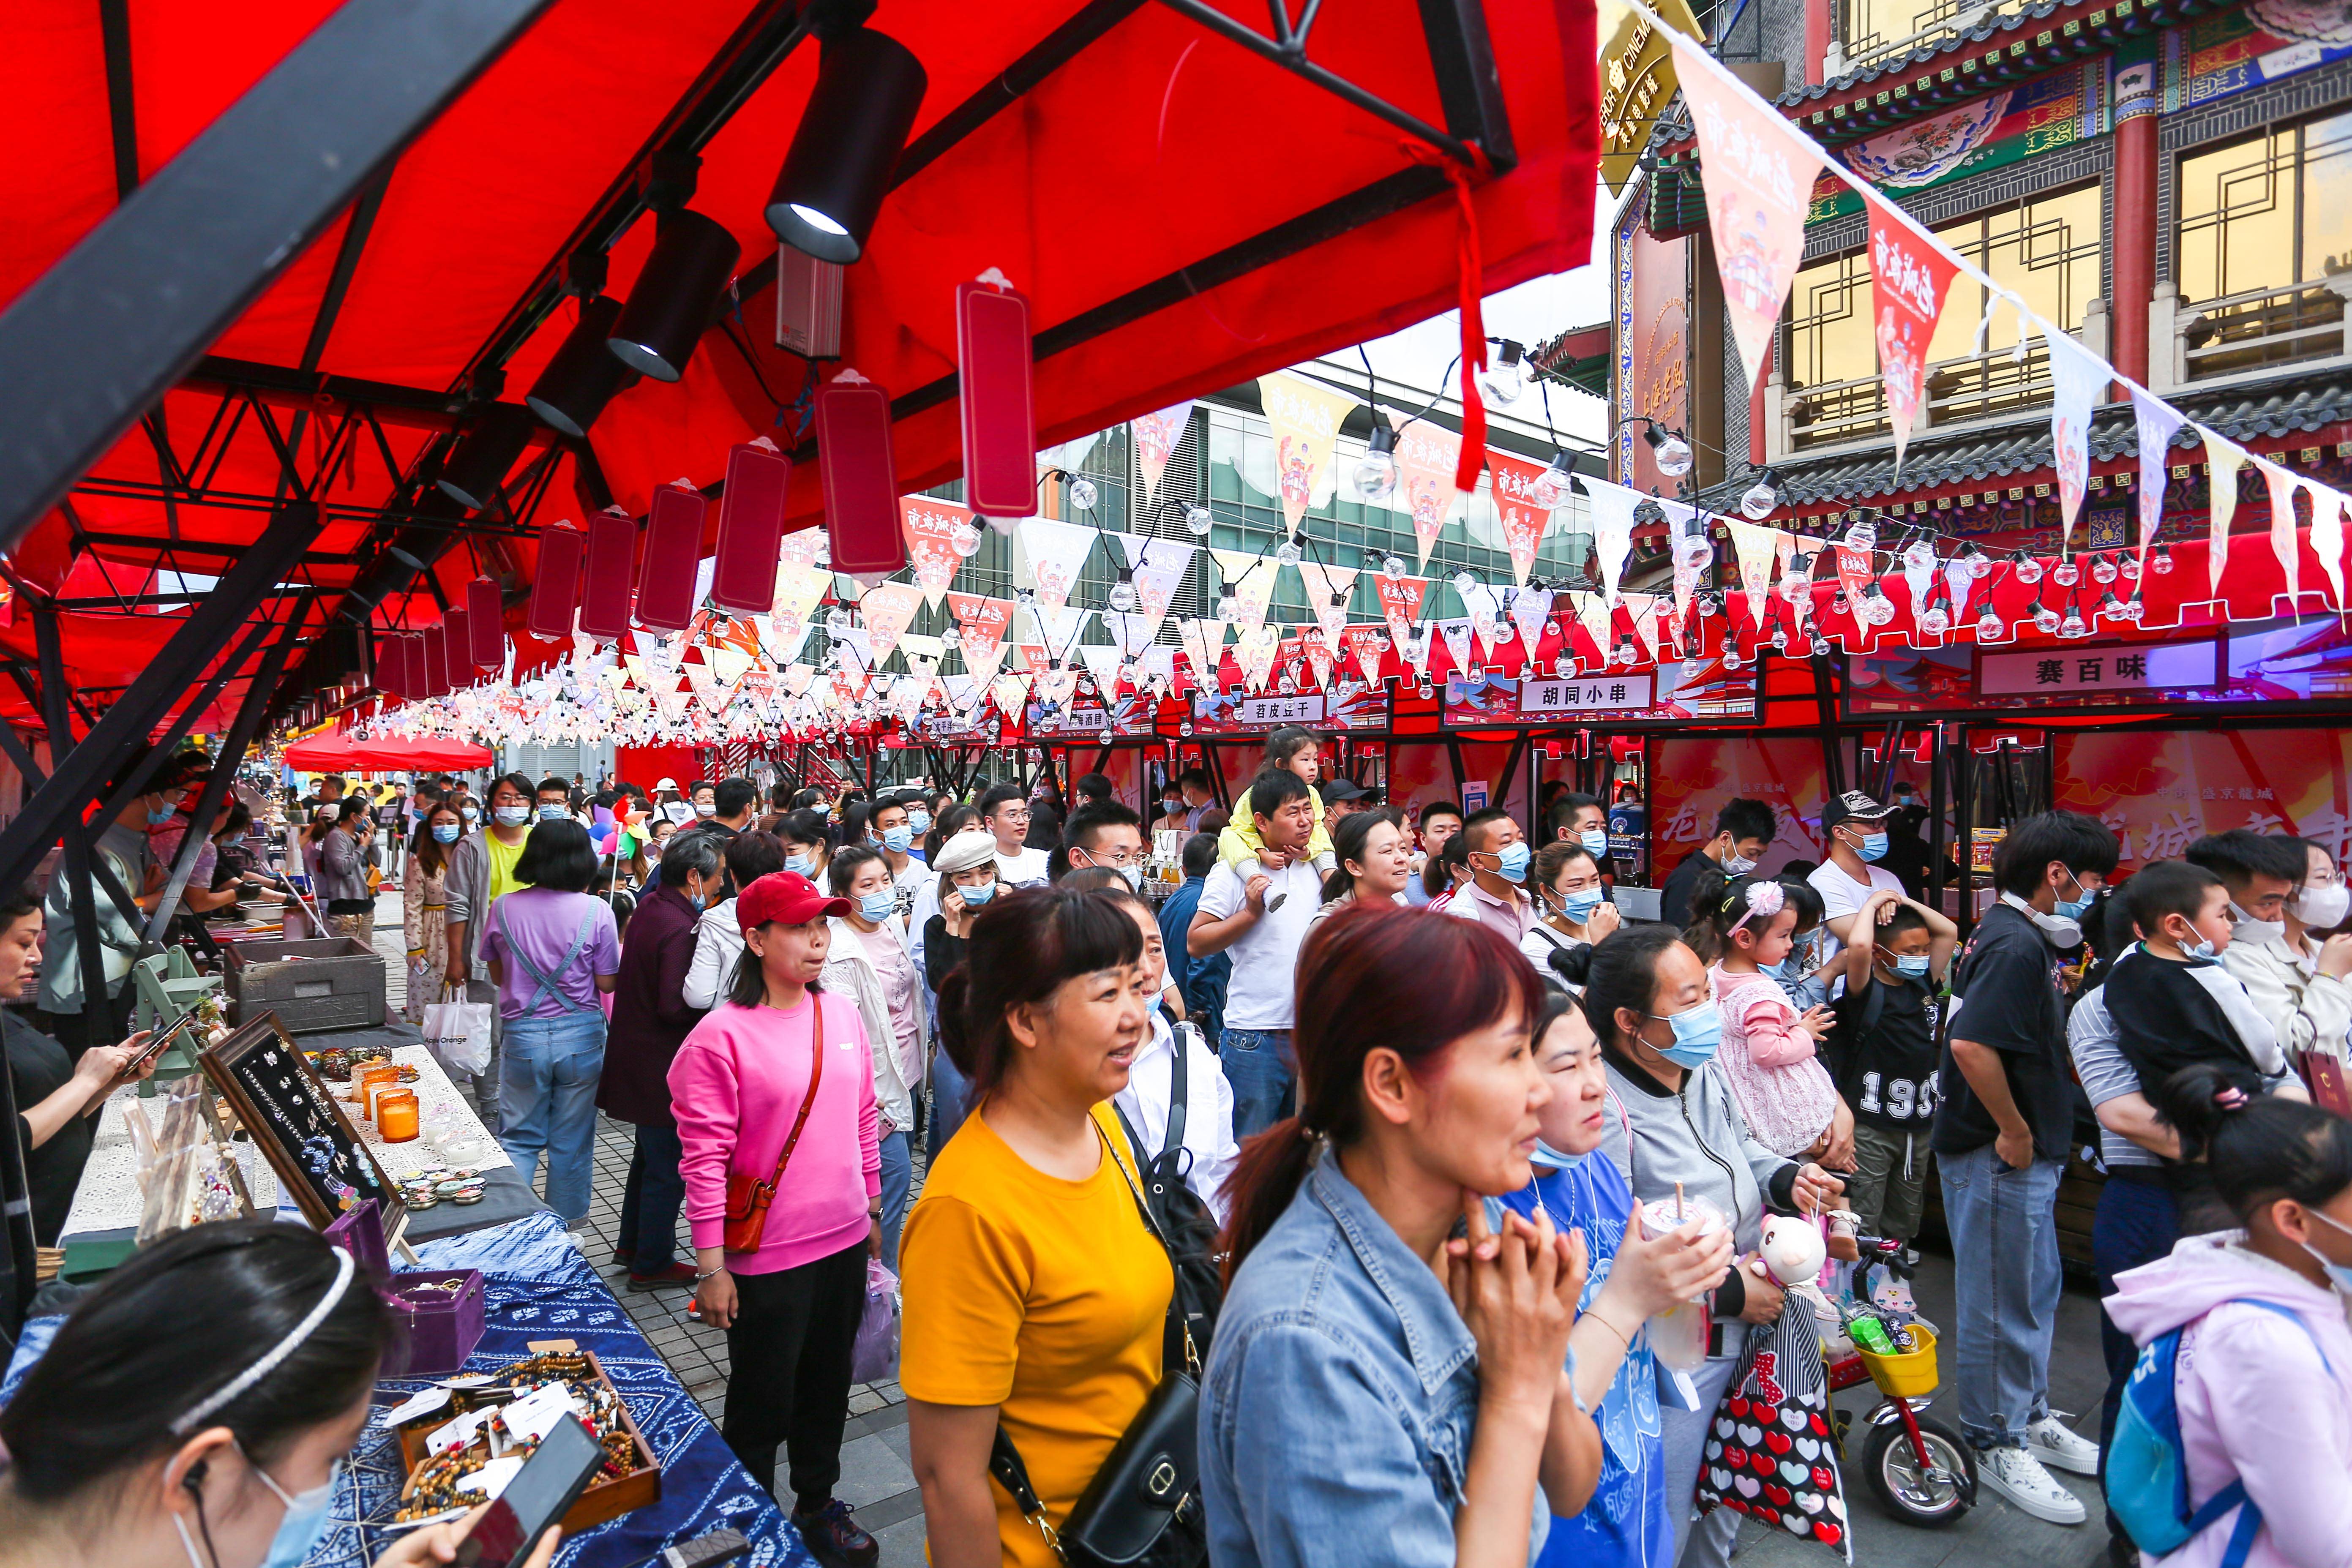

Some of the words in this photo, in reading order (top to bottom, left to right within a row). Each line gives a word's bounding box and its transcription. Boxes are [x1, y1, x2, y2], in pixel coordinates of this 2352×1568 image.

[1599, 89, 1617, 136] EROR
[2036, 654, 2147, 684] 赛百味
[1543, 684, 1626, 706] 胡同小串
[1068, 713, 1102, 726] 梅酒肆
